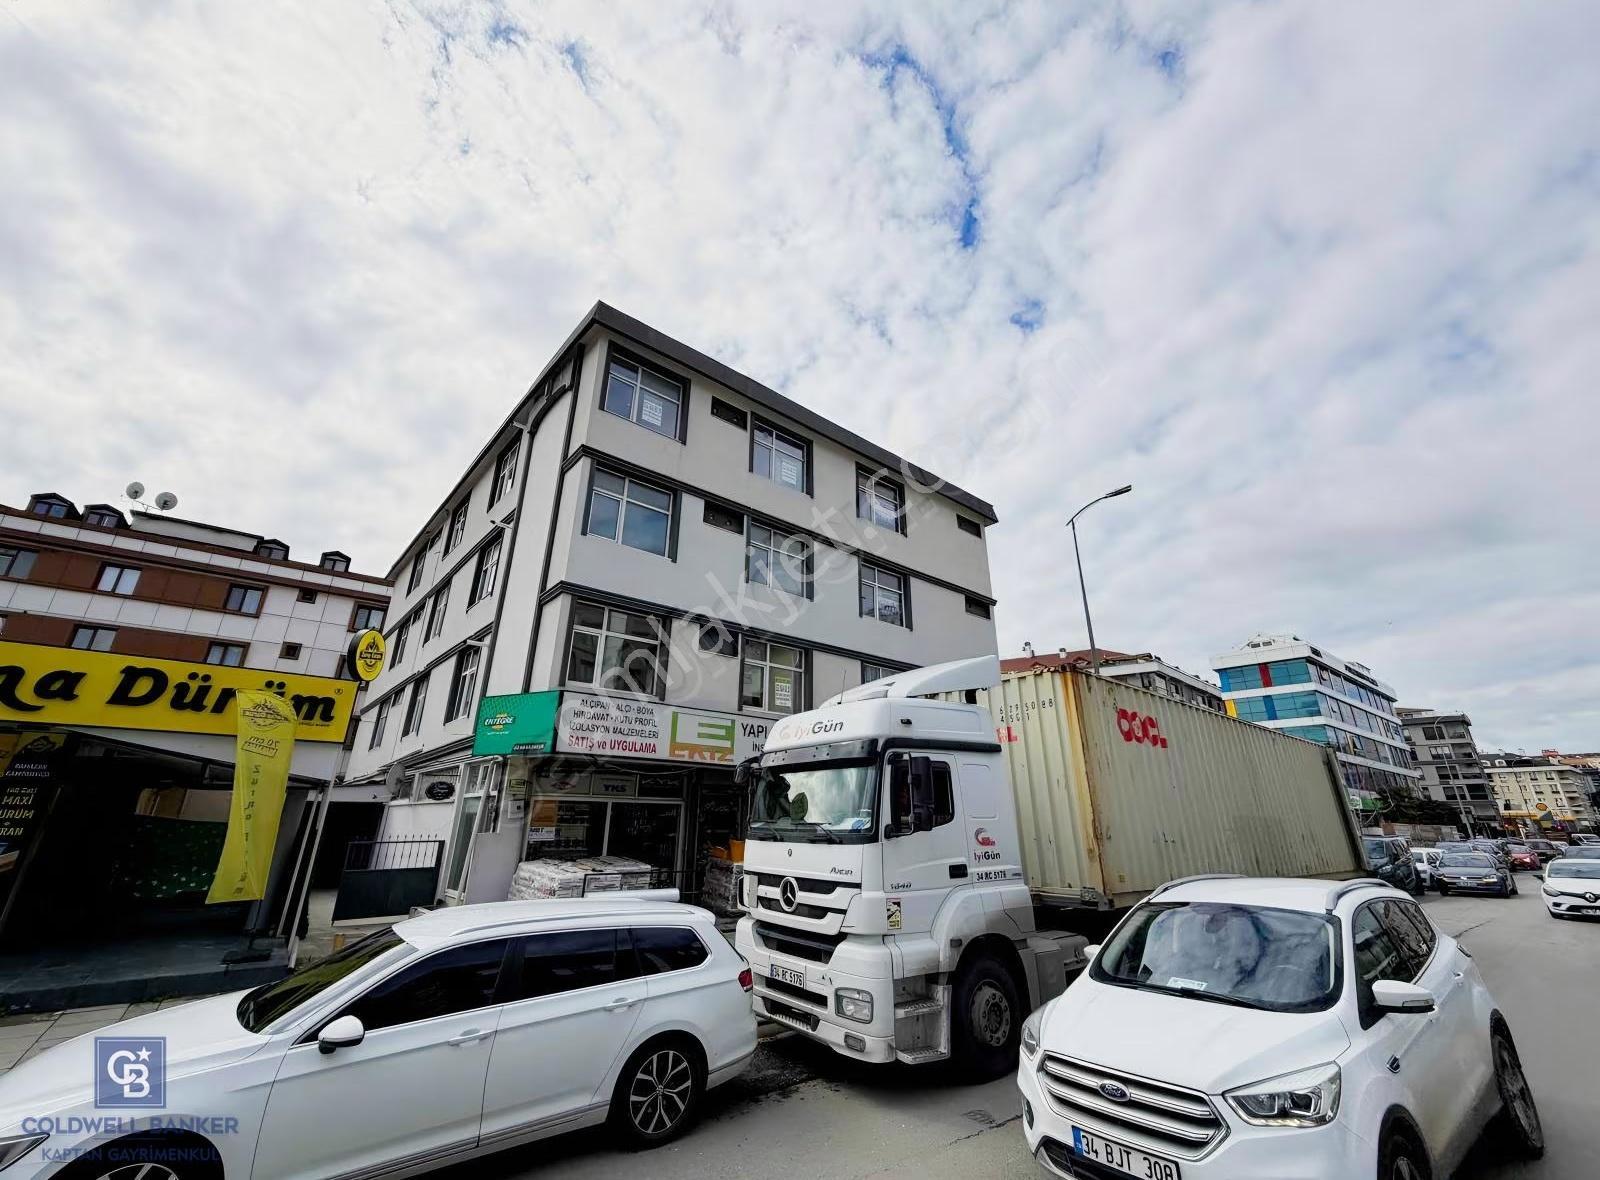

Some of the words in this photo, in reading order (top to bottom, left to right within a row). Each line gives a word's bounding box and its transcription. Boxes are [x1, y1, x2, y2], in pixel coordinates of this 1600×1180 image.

[636, 706, 654, 716] BOYA
[741, 722, 768, 739] YAPI
[568, 735, 595, 752] SATIŞ
[597, 740, 607, 750] ve
[609, 739, 657, 754] UYGULAMA
[1081, 1134, 1099, 1159] 34
[1105, 1142, 1131, 1172] BJT
